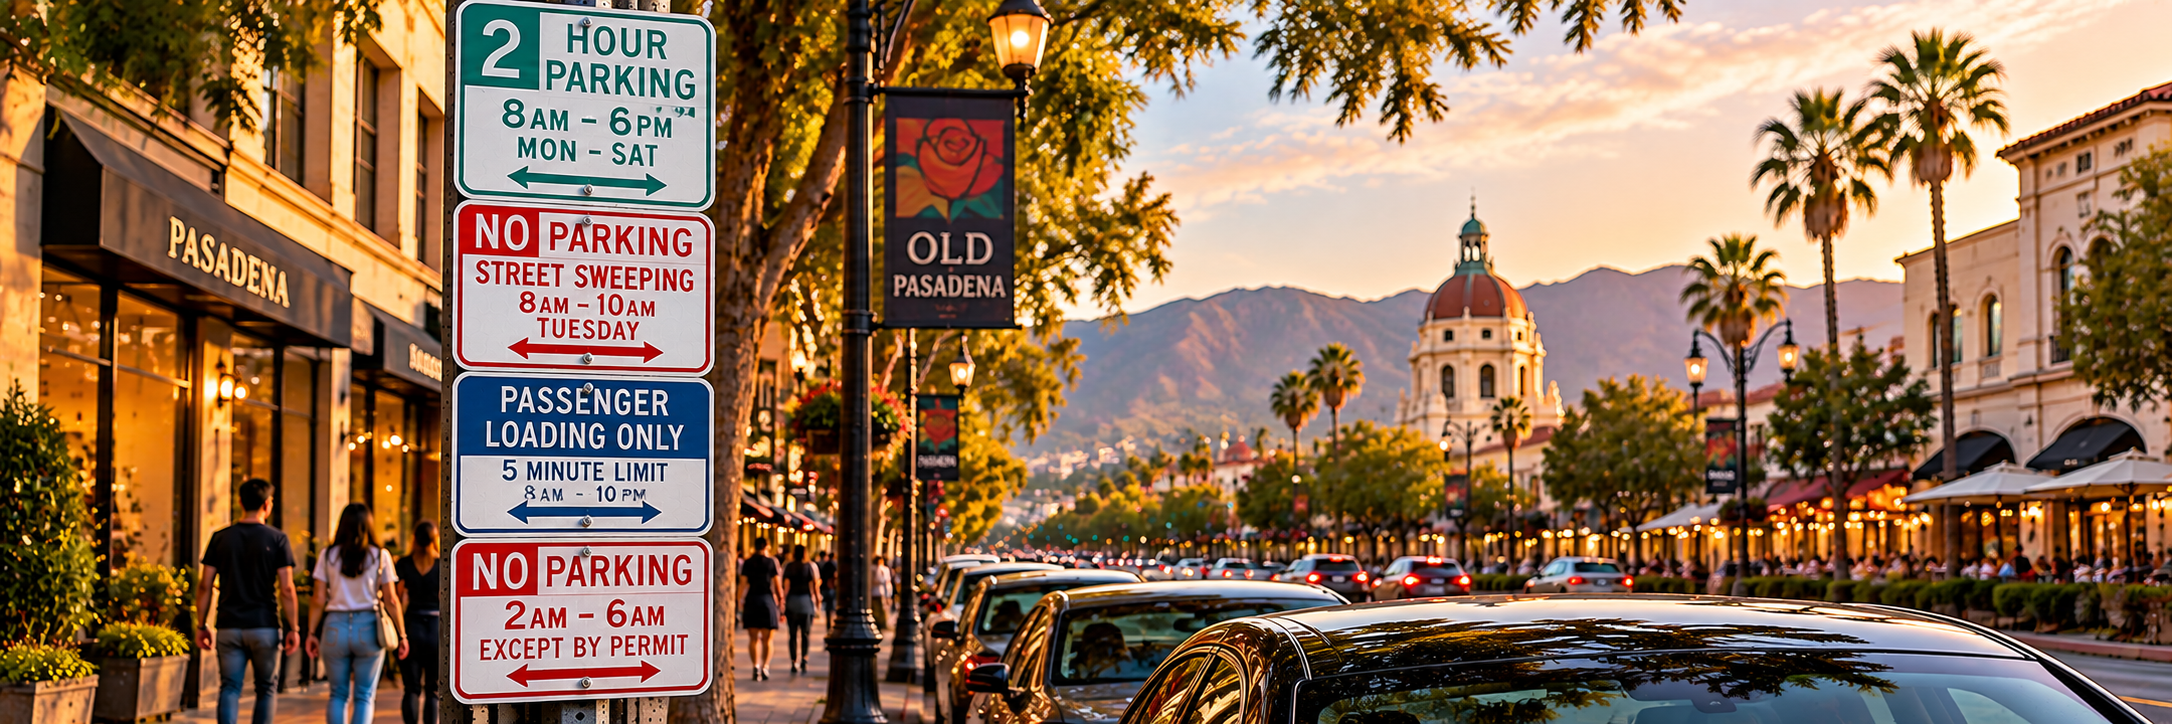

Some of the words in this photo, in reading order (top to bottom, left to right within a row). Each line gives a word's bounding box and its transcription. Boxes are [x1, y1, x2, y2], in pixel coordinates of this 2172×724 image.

[481, 19, 521, 79] 2
[567, 23, 668, 60] HOUR
[546, 59, 696, 101] PARKING
[517, 136, 577, 162] MON
[611, 142, 659, 167] SAT
[475, 212, 530, 251] NO
[549, 221, 693, 258] PARKING
[906, 230, 994, 266] OLD
[167, 215, 291, 309] PASADENA
[475, 259, 565, 288] STREET
[574, 264, 694, 293] SWEEPING
[893, 273, 1007, 299] PASADENA
[536, 316, 640, 341] TUESDAY
[501, 385, 669, 417] PASSENGER
[486, 420, 606, 450] LOADING
[616, 423, 685, 451] ONLY
[502, 459, 518, 482] 5
[526, 460, 605, 482] MINUTE
[614, 461, 669, 482] LIMIT
[472, 551, 529, 591] NO
[546, 554, 692, 588] PARKING
[479, 636, 564, 661] EXCEPT
[573, 635, 602, 658] BY
[610, 633, 689, 657] PERMIT
